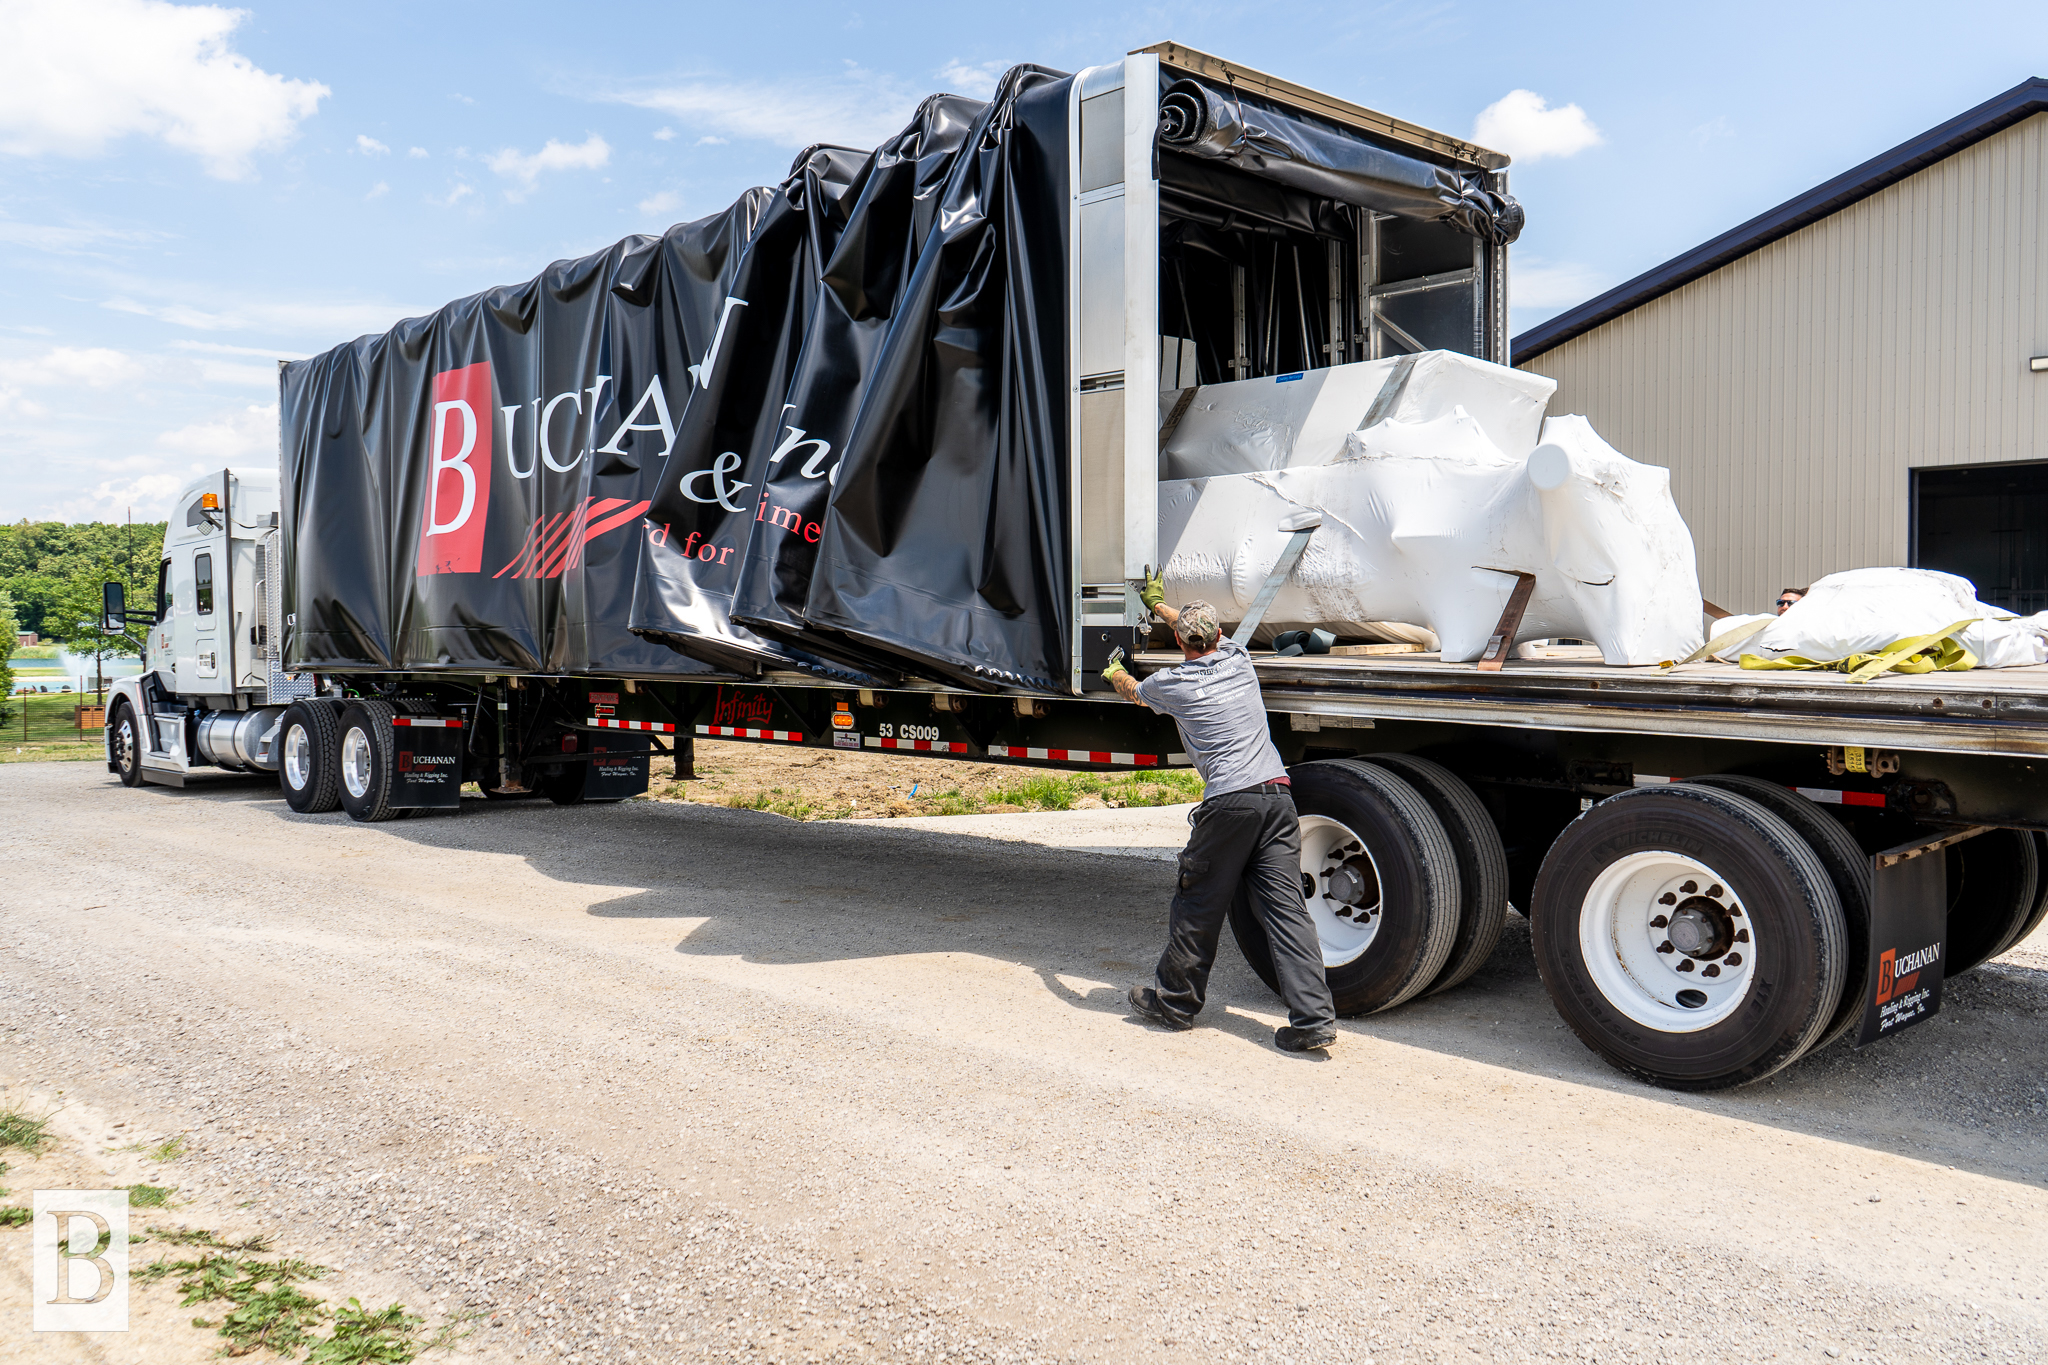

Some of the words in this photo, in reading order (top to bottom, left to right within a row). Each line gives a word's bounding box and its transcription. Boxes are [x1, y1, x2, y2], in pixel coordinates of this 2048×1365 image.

[680, 452, 753, 513] &
[680, 531, 735, 565] for
[1198, 674, 1218, 685] Since
[1217, 665, 1237, 678] 1996
[711, 685, 774, 725] Infinity
[879, 723, 893, 737] 53
[900, 724, 940, 741] CS009
